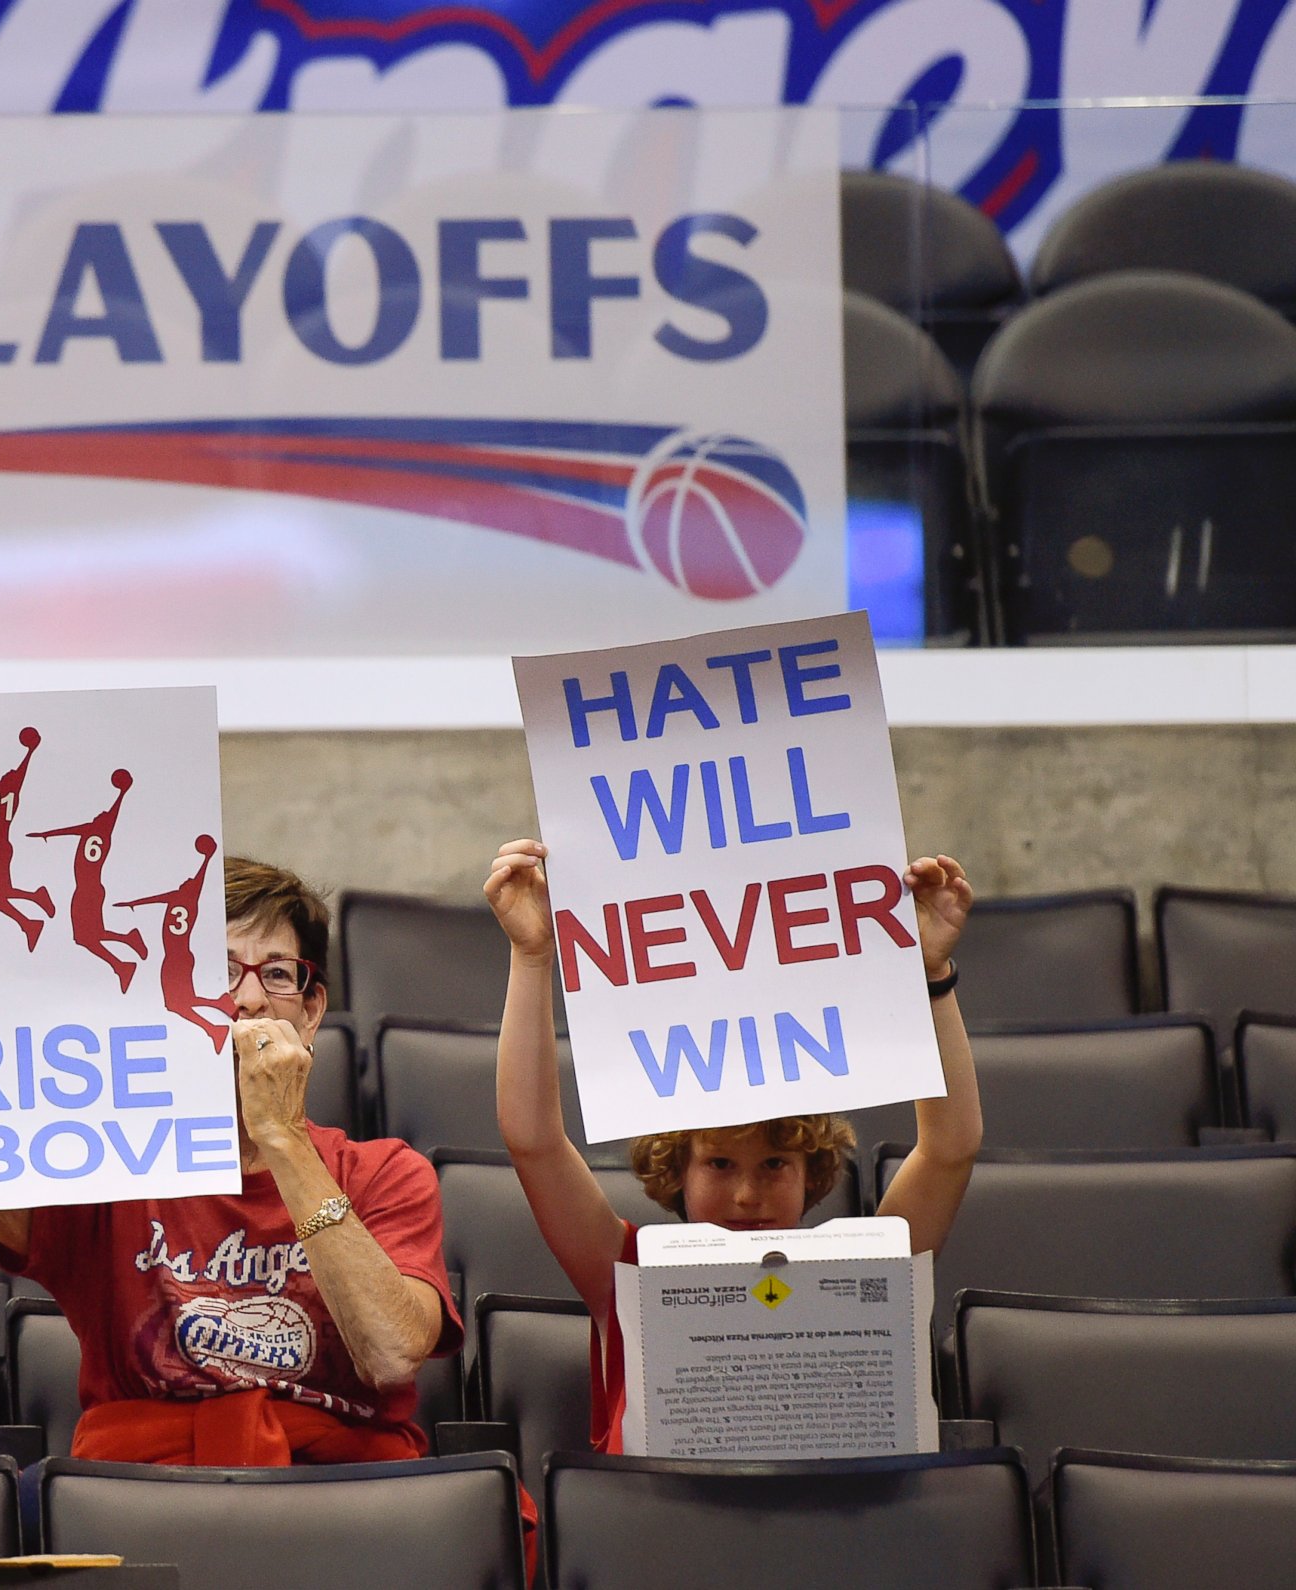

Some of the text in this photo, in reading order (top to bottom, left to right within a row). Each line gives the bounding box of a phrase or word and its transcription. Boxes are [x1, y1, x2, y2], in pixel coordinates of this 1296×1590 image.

[562, 639, 852, 748] HATE
[590, 747, 851, 860] WILL
[84, 835, 103, 862] 6
[169, 906, 189, 935] 3
[555, 864, 917, 992] NEVER
[628, 1006, 850, 1097] WIN
[204, 1229, 311, 1294] Ange
[661, 1293, 746, 1308] california
[688, 1335, 724, 1343] Kitchen.
[726, 1334, 749, 1342] Pizza
[750, 1332, 793, 1341] California
[805, 1331, 812, 1339] it
[863, 1329, 870, 1337] is
